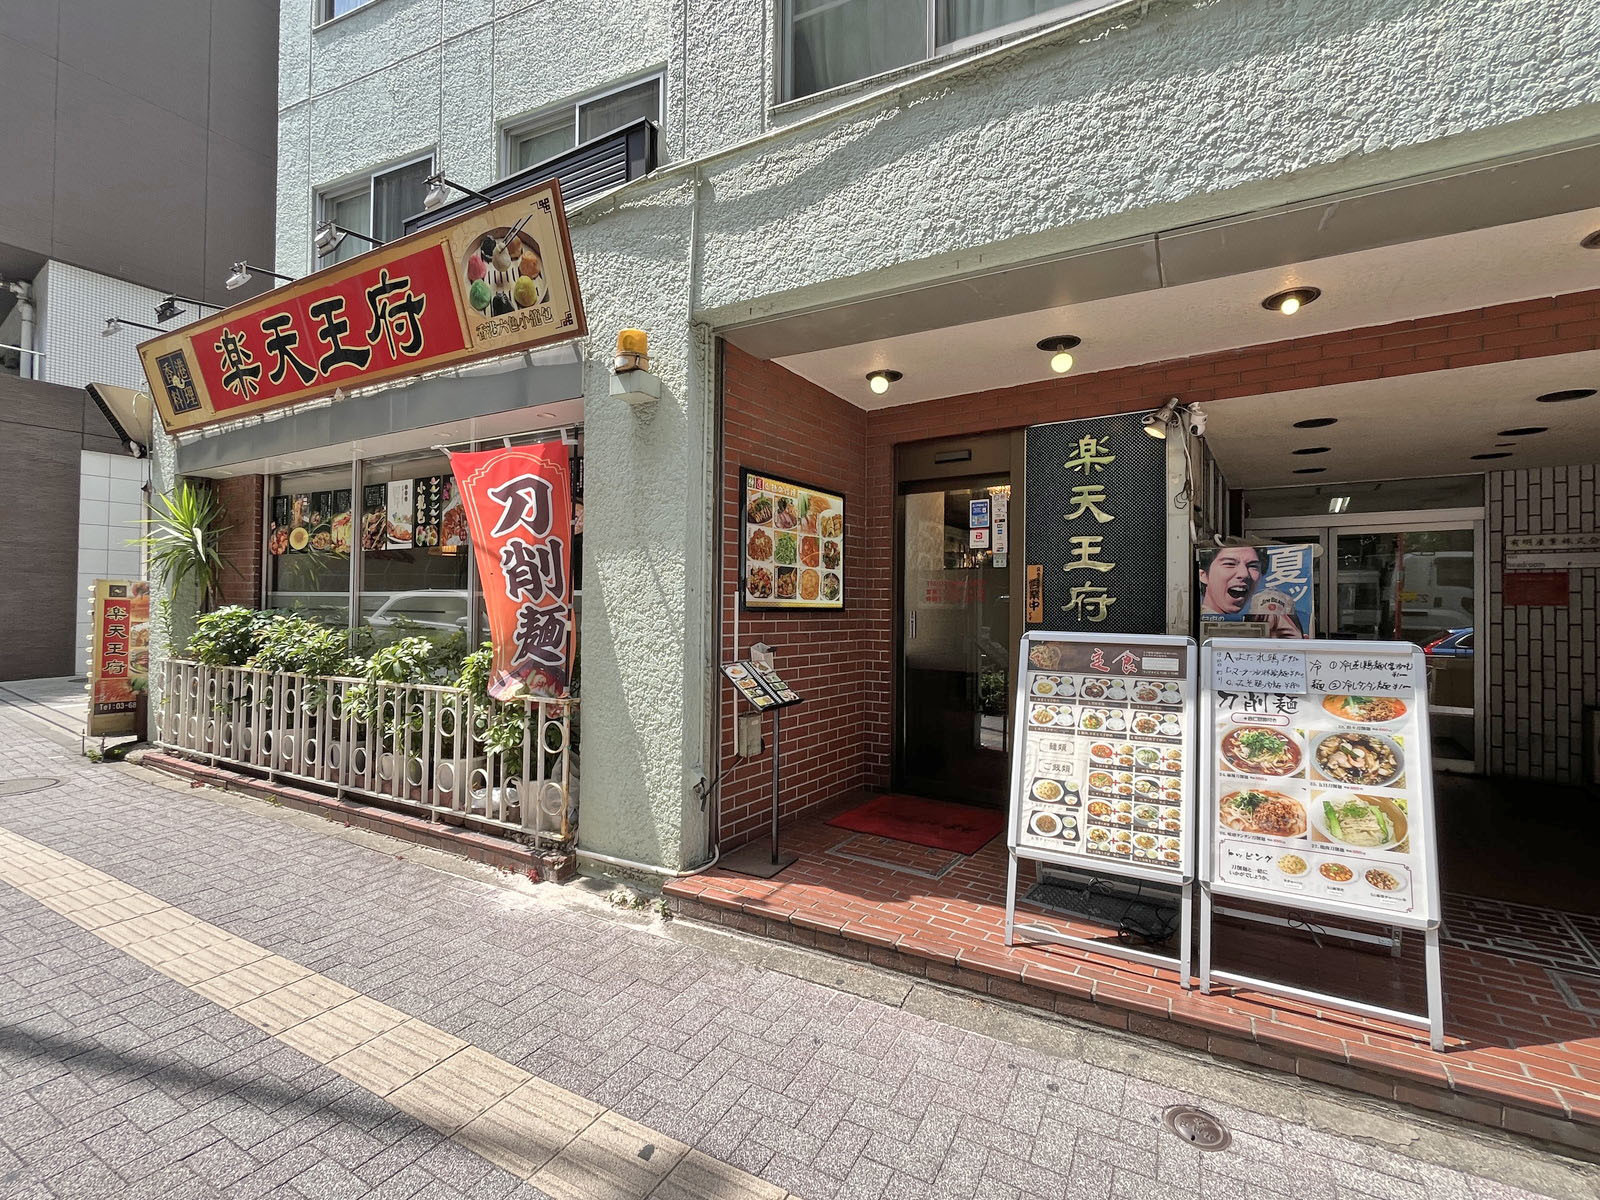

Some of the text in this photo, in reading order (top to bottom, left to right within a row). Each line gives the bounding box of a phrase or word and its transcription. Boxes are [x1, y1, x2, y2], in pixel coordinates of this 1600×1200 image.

[214, 268, 426, 400] 楽天王府
[1061, 434, 1117, 623] 楽天王府
[487, 473, 569, 667] 刀削麺
[103, 606, 129, 675] 楽天王府
[1089, 647, 1141, 674] 定食
[1217, 690, 1300, 715] 刀削麺
[1043, 763, 1071, 773] ご飯類
